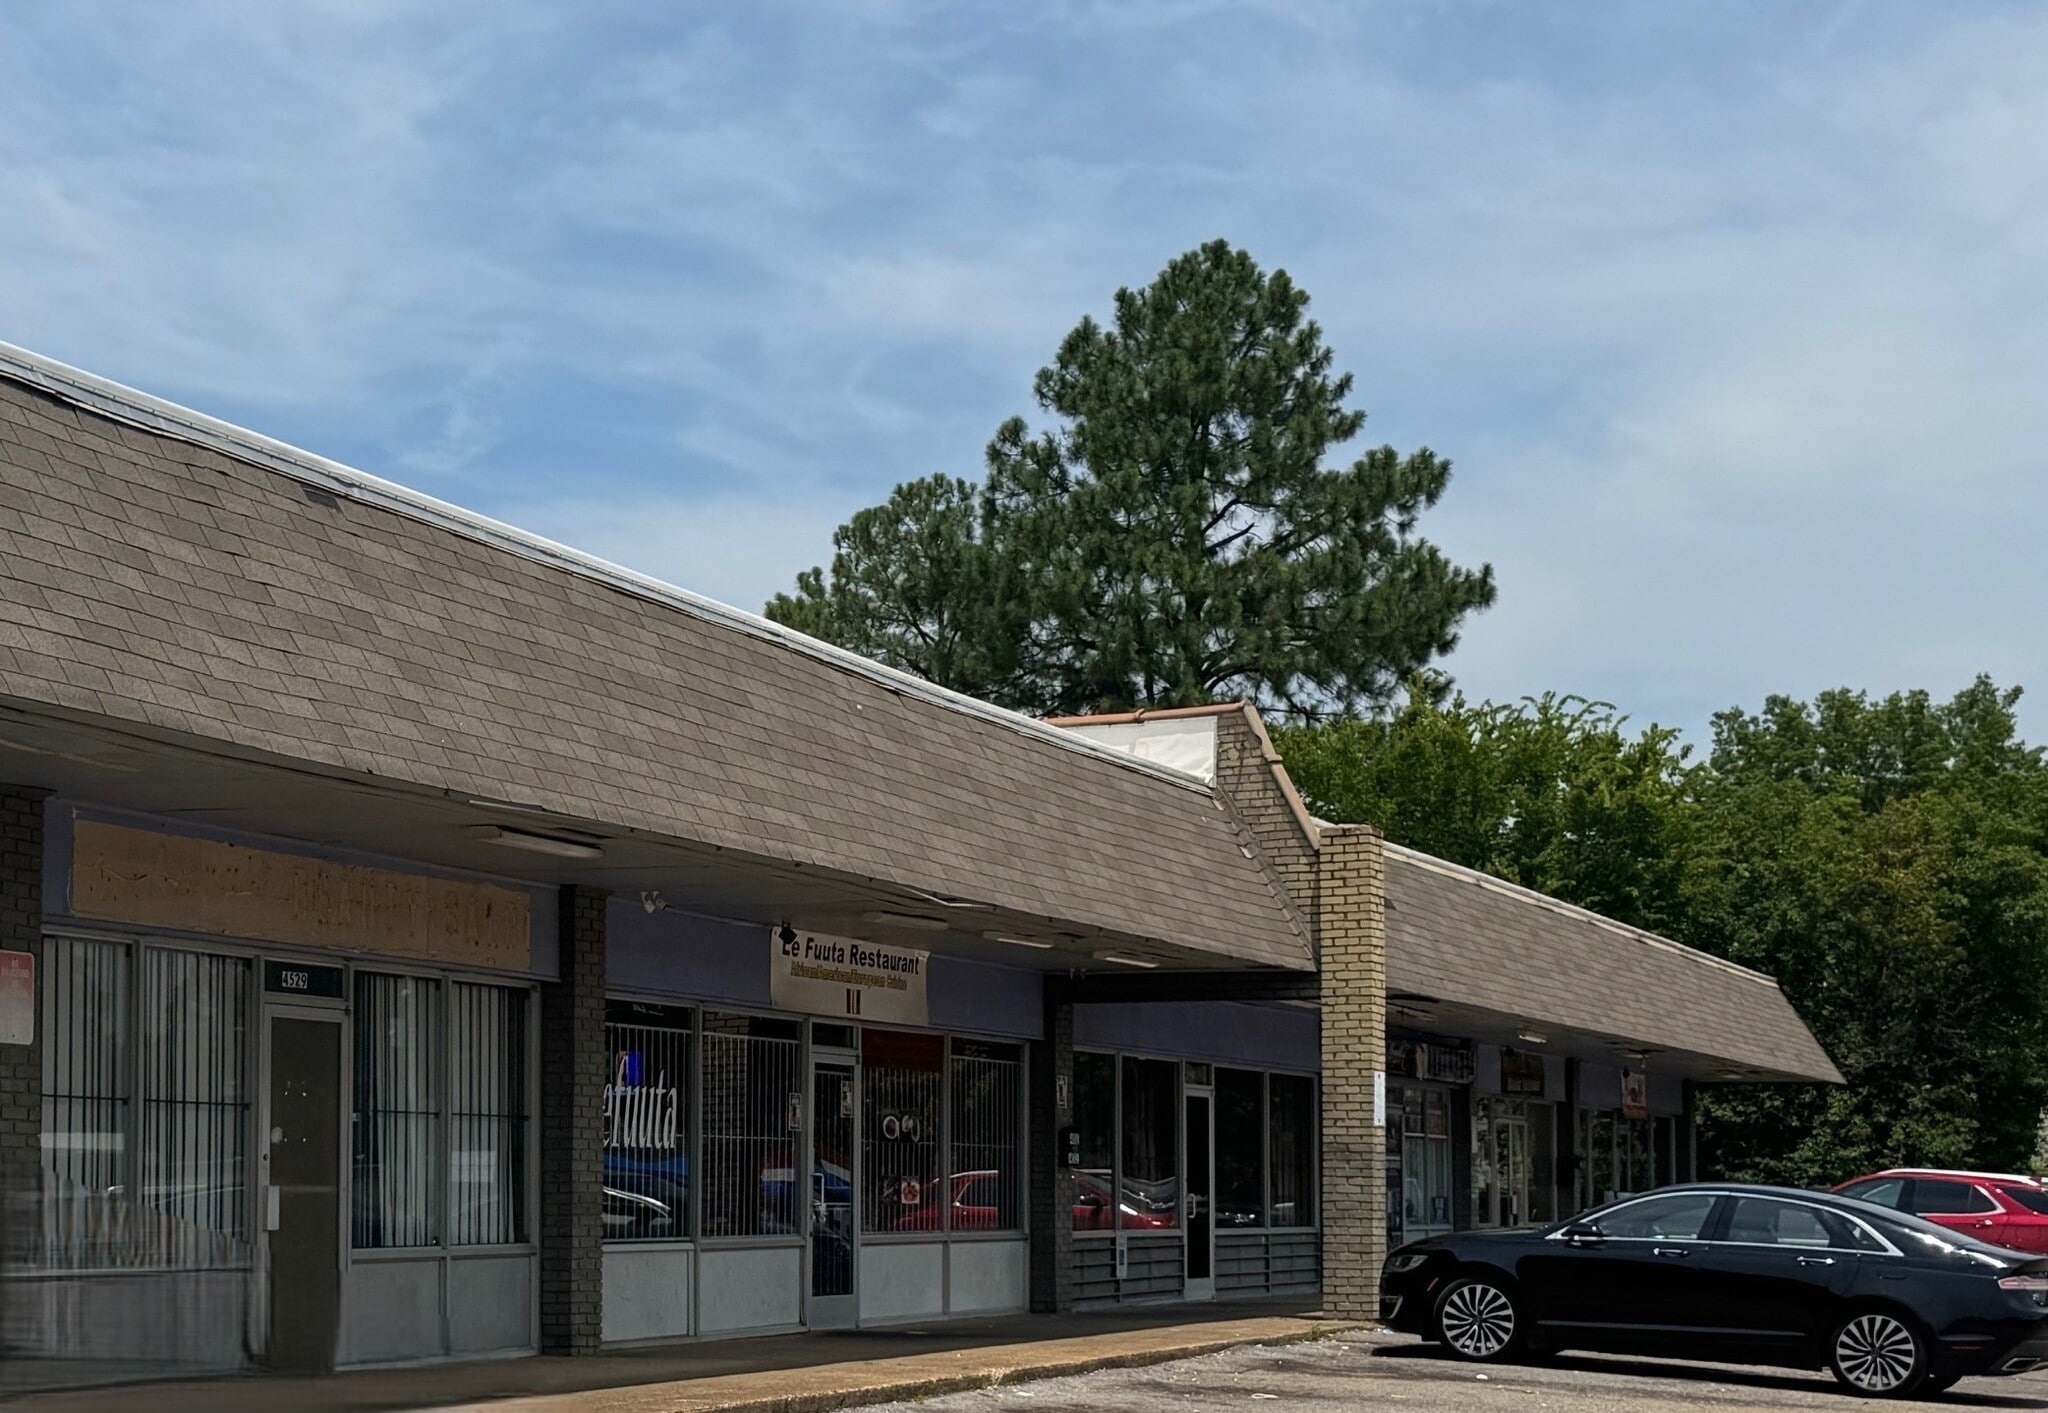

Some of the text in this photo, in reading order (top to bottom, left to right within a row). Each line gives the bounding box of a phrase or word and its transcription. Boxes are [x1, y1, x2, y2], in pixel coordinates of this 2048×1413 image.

[804, 937, 845, 964] Fuuta
[849, 943, 919, 975] Restaurant
[282, 972, 307, 988] 4529
